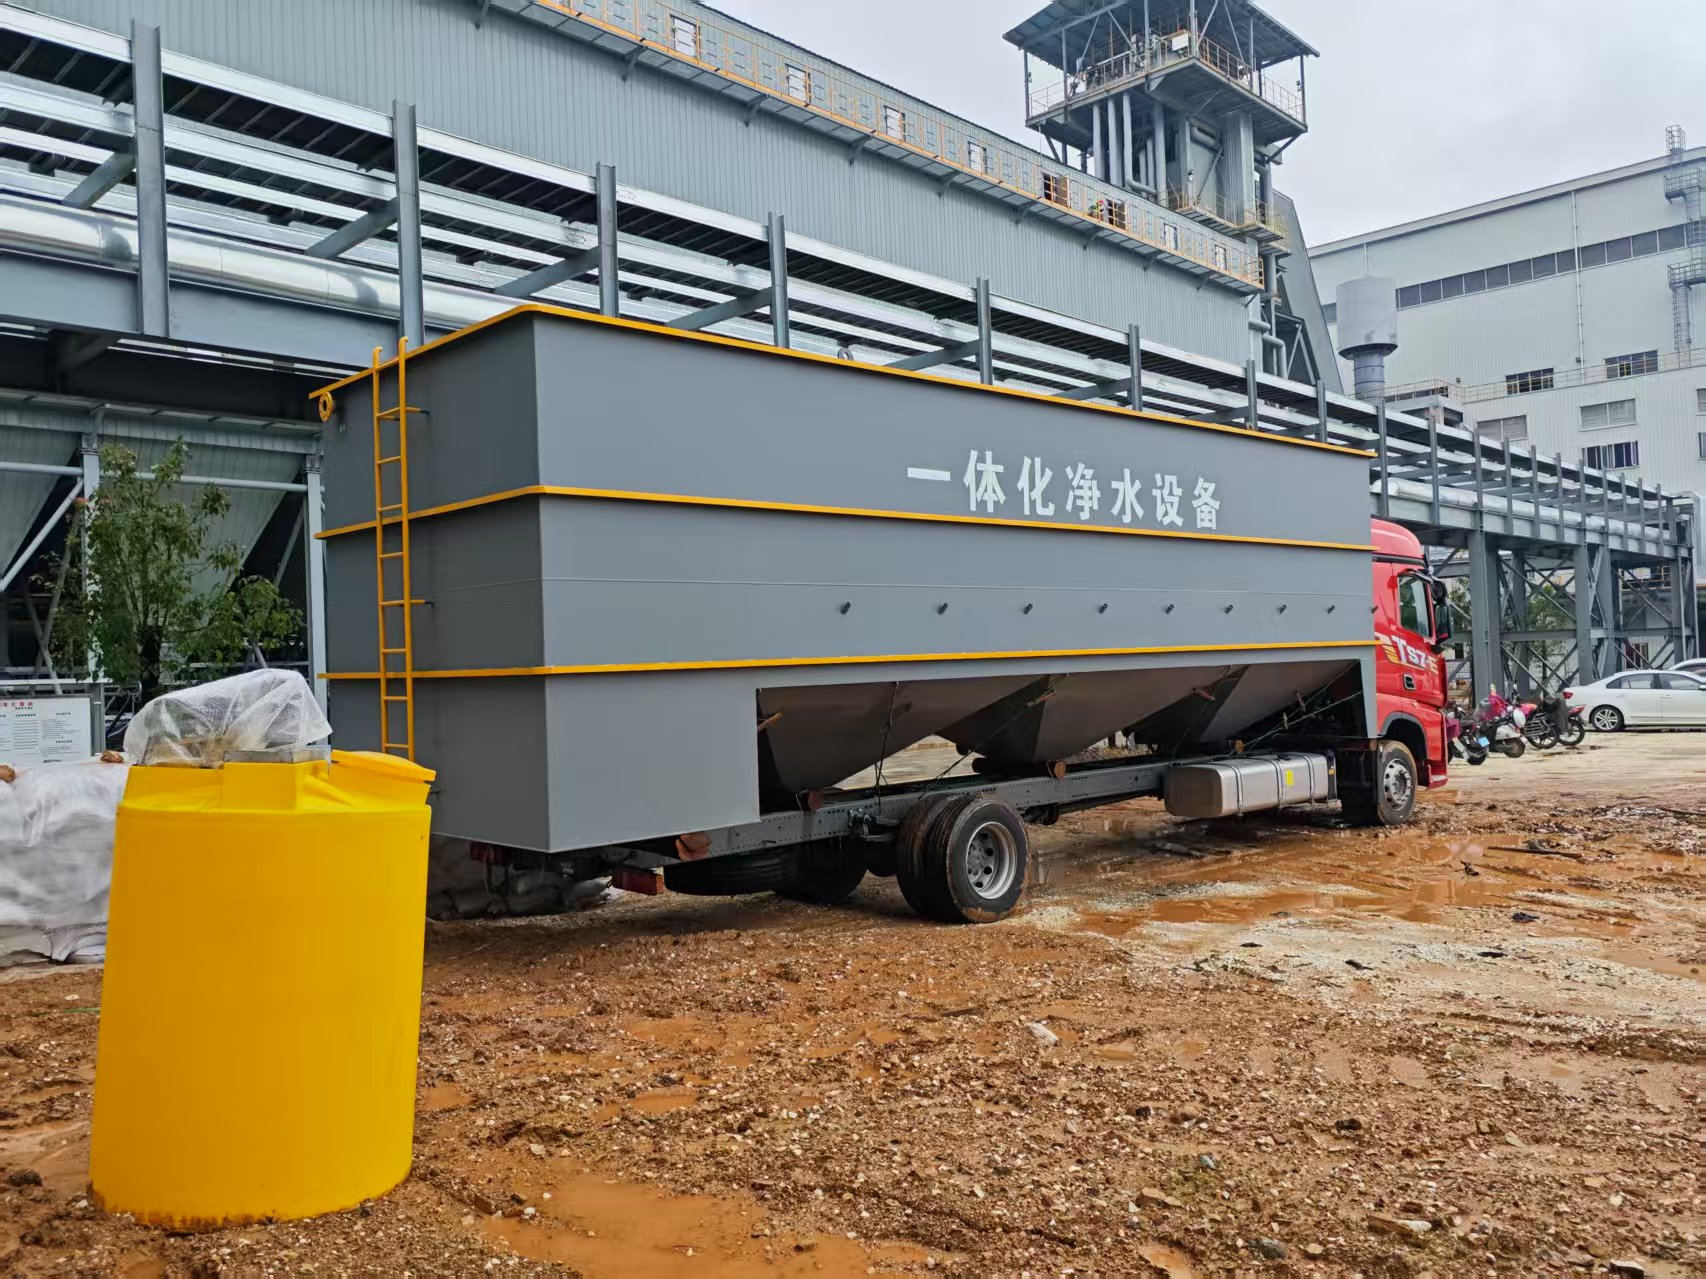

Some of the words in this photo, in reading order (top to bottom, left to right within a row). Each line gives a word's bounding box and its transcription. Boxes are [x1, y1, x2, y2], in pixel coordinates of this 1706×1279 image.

[907, 449, 1221, 529] 一体化净水设备
